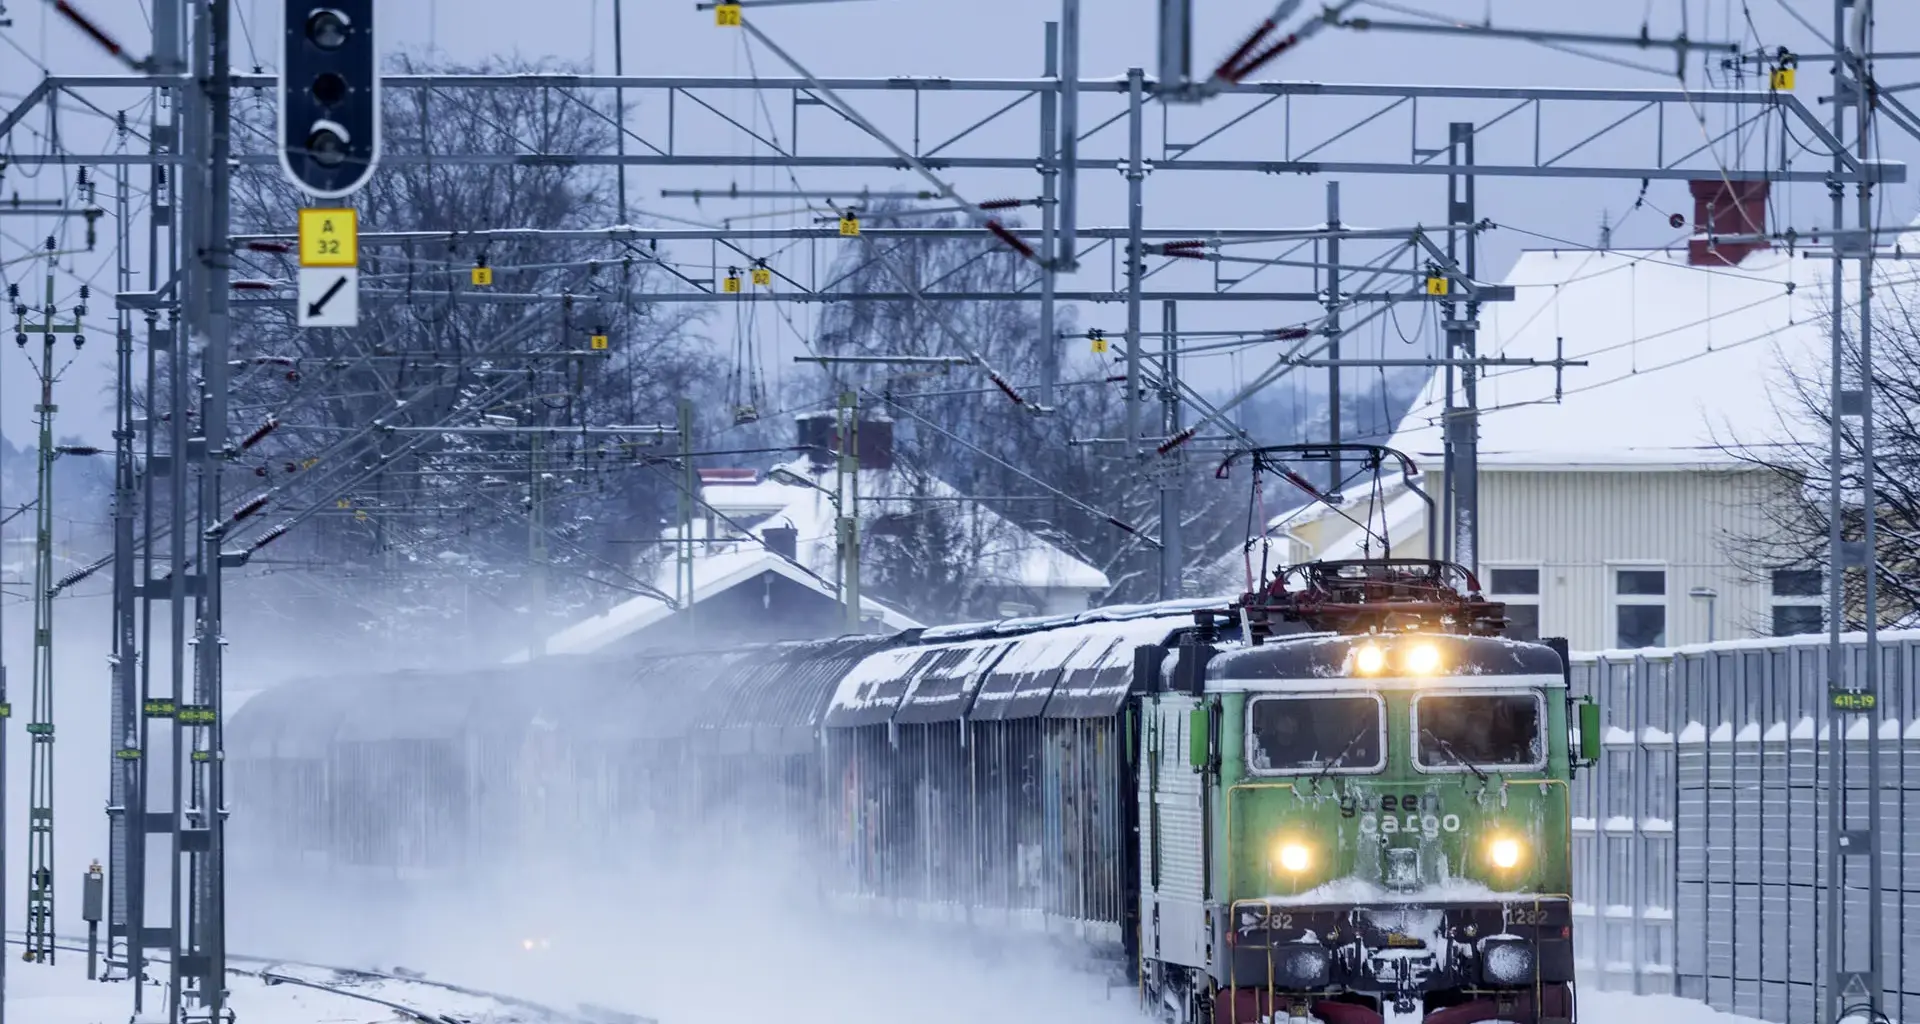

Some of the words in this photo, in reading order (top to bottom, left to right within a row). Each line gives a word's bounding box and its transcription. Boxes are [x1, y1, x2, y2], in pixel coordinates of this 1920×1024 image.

[719, 10, 737, 25] D2
[1777, 74, 1786, 88] A
[322, 219, 334, 233] A
[317, 239, 341, 254] 32
[1834, 695, 1874, 707] 411-19
[1340, 794, 1440, 818] green
[1360, 814, 1460, 839] cargo
[1257, 913, 1293, 930] 282
[1507, 909, 1549, 925] 1282
